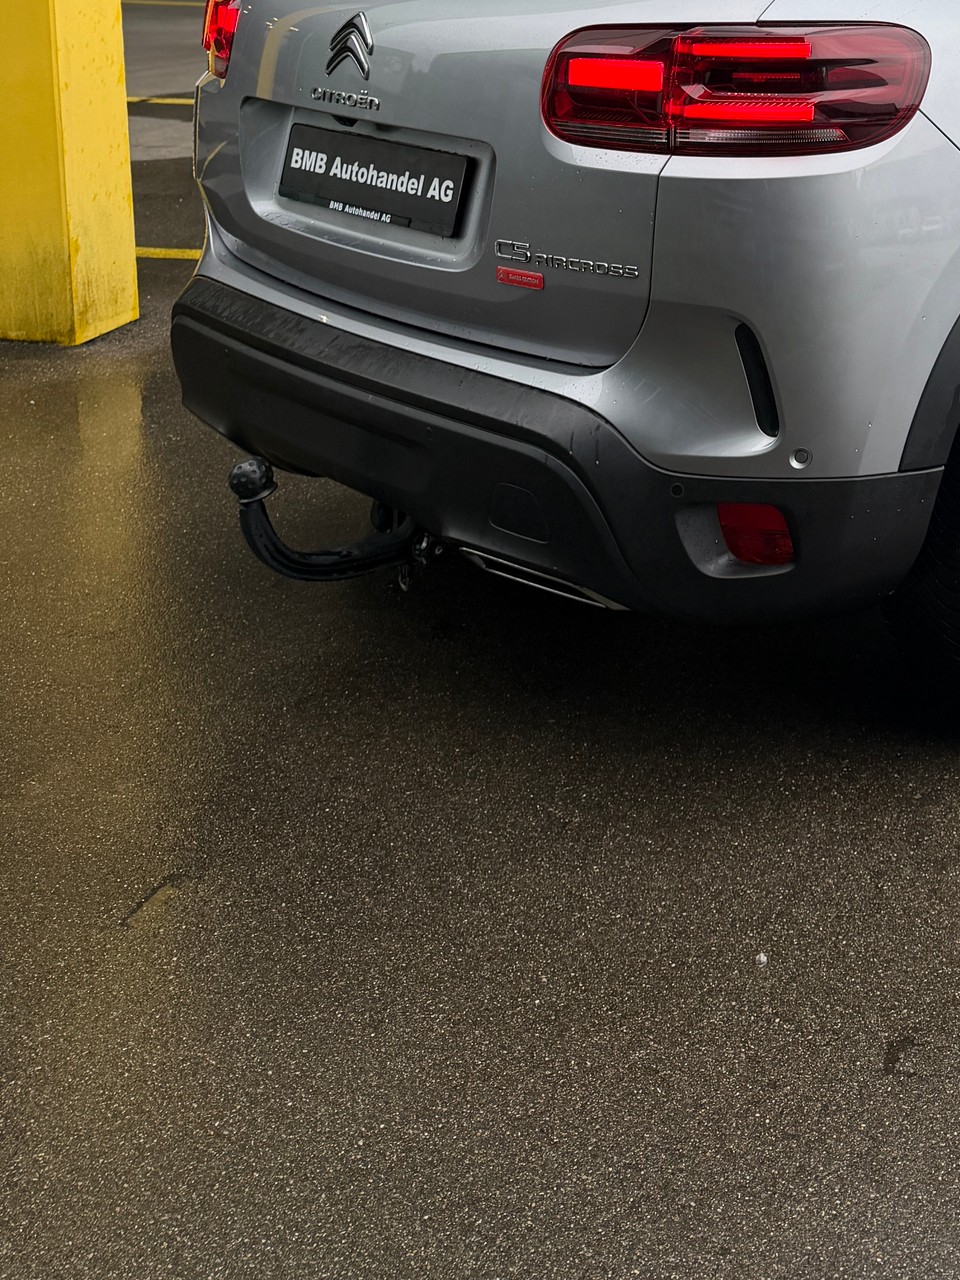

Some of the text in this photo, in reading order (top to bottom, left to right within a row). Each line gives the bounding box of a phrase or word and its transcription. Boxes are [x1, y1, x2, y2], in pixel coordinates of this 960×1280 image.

[311, 87, 380, 111] CITROËN
[290, 147, 454, 202] BMB Autohandel AG
[329, 200, 391, 223] BMB Autohandel AG
[495, 239, 640, 278] C5 AIRCROSS
